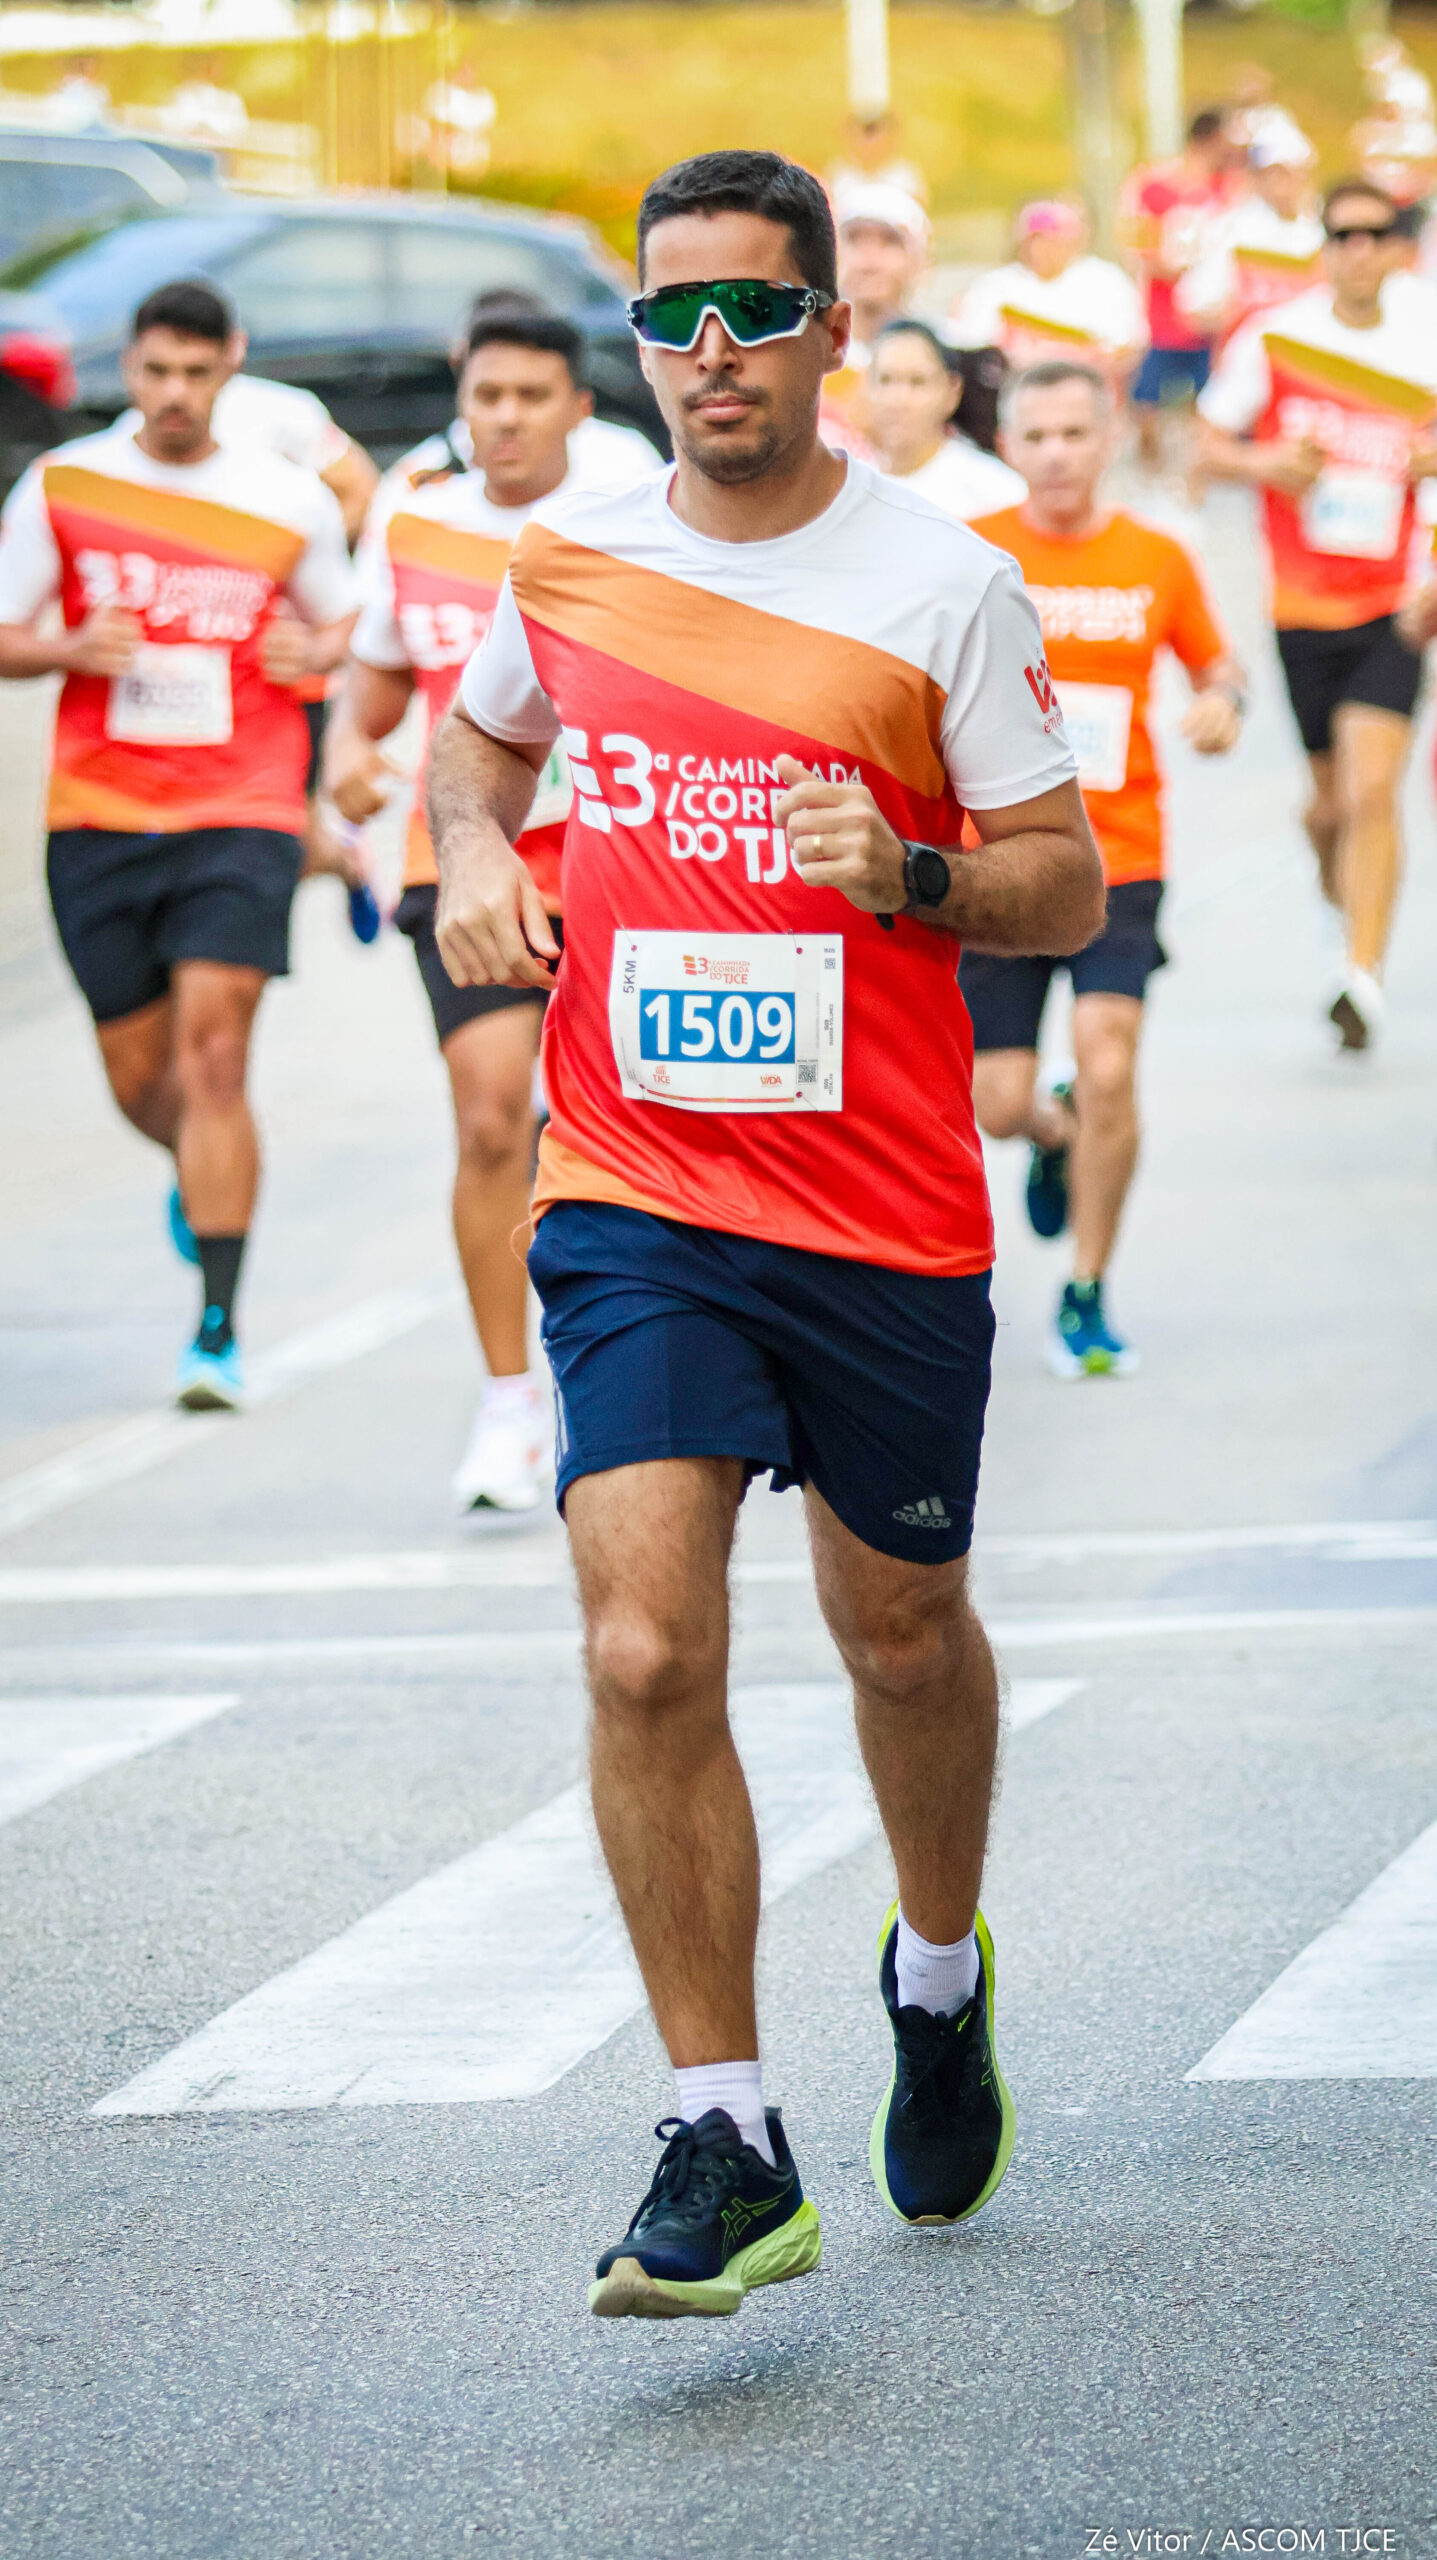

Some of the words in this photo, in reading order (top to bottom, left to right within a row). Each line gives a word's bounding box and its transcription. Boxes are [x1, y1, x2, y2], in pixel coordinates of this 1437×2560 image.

[678, 755, 863, 786] CAMINADA
[666, 820, 728, 862] DO
[623, 960, 637, 994] 5KM
[710, 972, 722, 981] DO
[723, 974, 748, 985] TJCE
[644, 994, 793, 1059] 1509
[653, 1074, 671, 1084] TJCE
[892, 1510, 952, 1529] adidas
